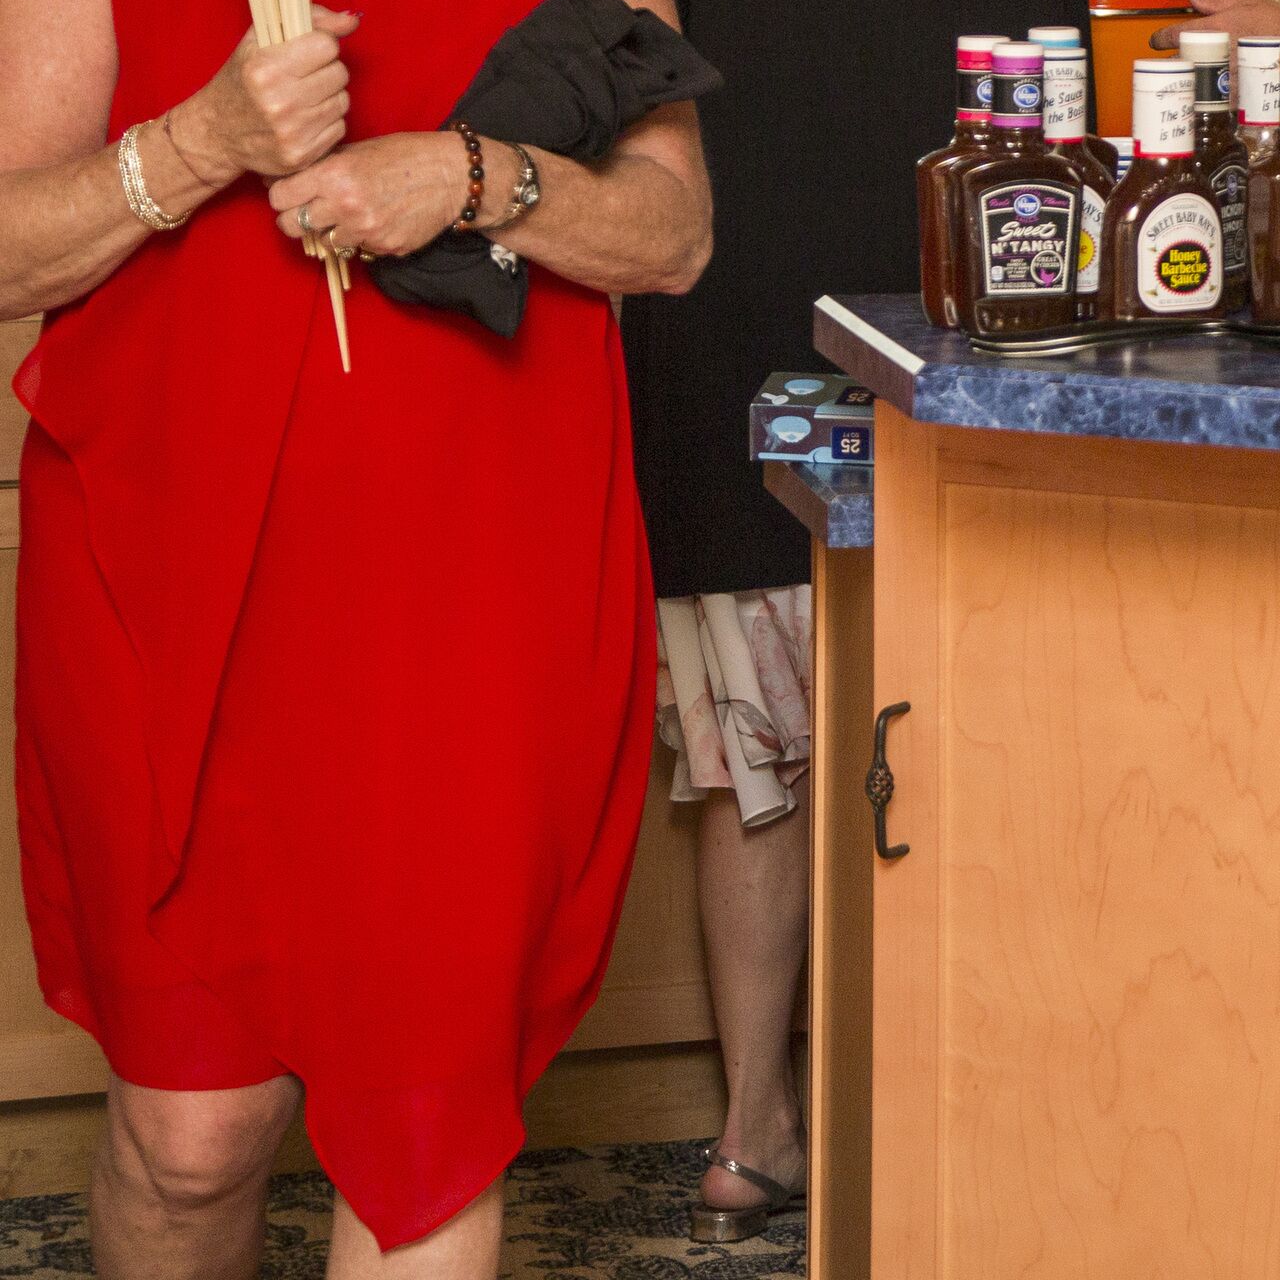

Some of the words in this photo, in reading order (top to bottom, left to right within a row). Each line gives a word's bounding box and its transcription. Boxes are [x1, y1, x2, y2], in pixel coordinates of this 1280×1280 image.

[997, 220, 1057, 241] Sweet
[1146, 215, 1175, 241] SWEET
[1175, 210, 1197, 223] BABY
[1009, 240, 1065, 255] TANGY
[1169, 249, 1201, 264] Honey
[1161, 261, 1207, 276] Barbecue
[840, 438, 860, 454] 25
